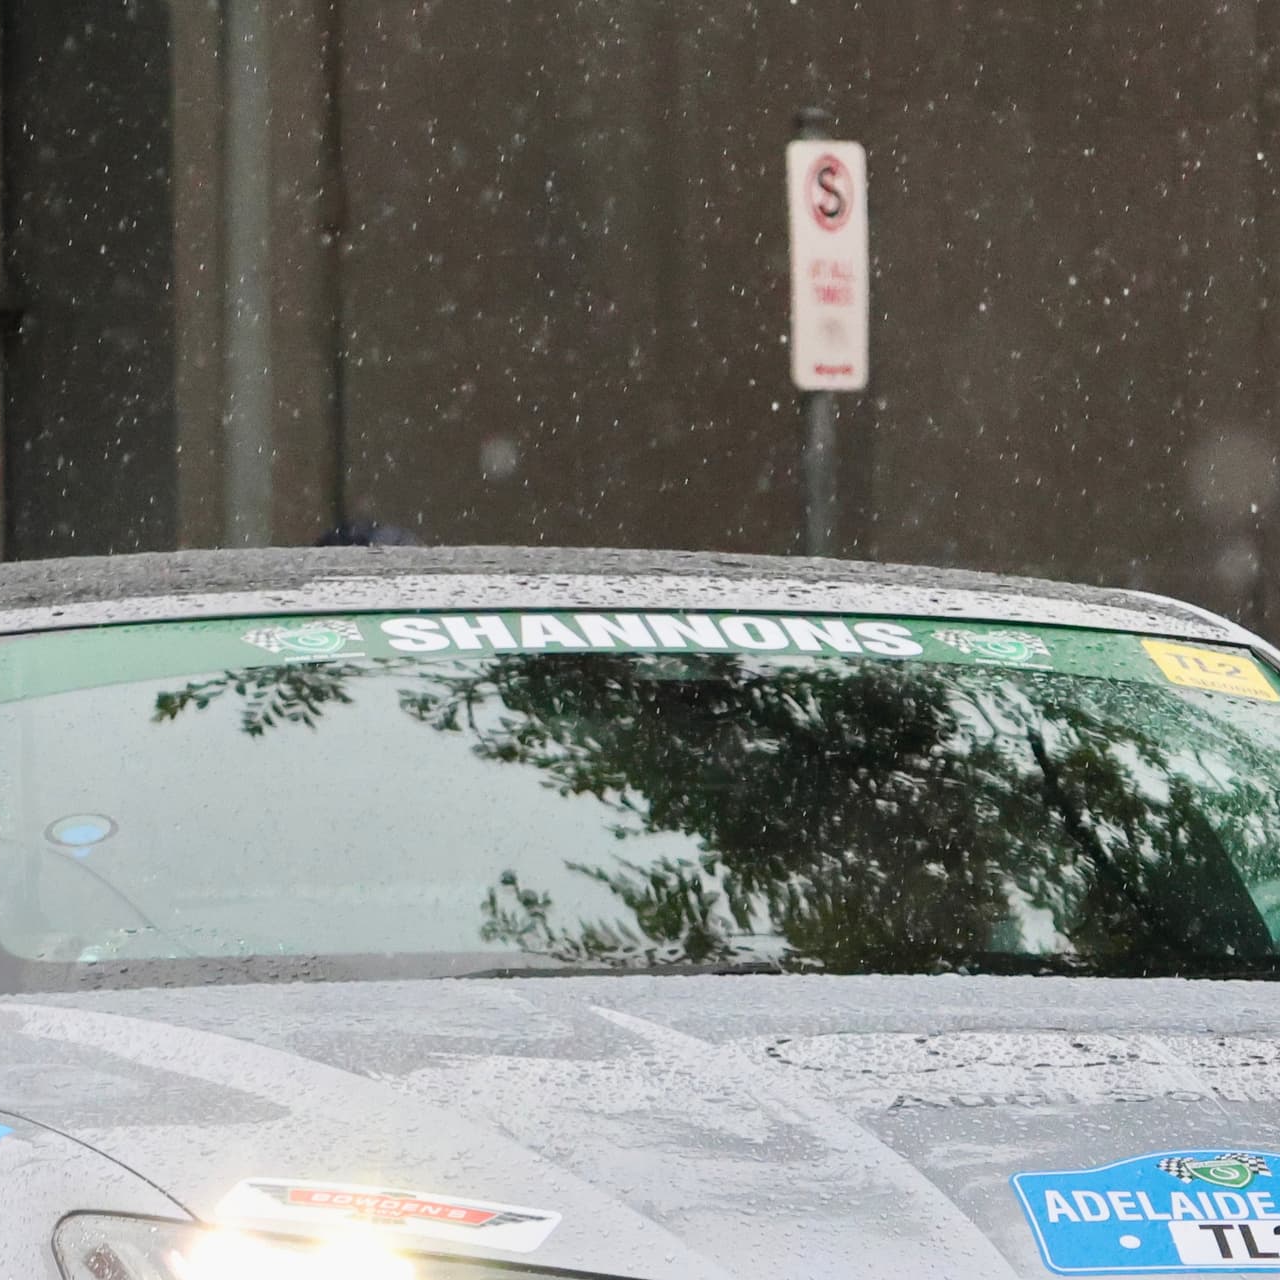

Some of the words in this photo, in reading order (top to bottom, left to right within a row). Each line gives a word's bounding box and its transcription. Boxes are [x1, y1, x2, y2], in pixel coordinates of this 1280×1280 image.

[817, 165, 846, 219] S
[379, 613, 923, 658] SHANNONS
[1164, 651, 1248, 680] TL2
[310, 1192, 468, 1219] BOWDEN'S
